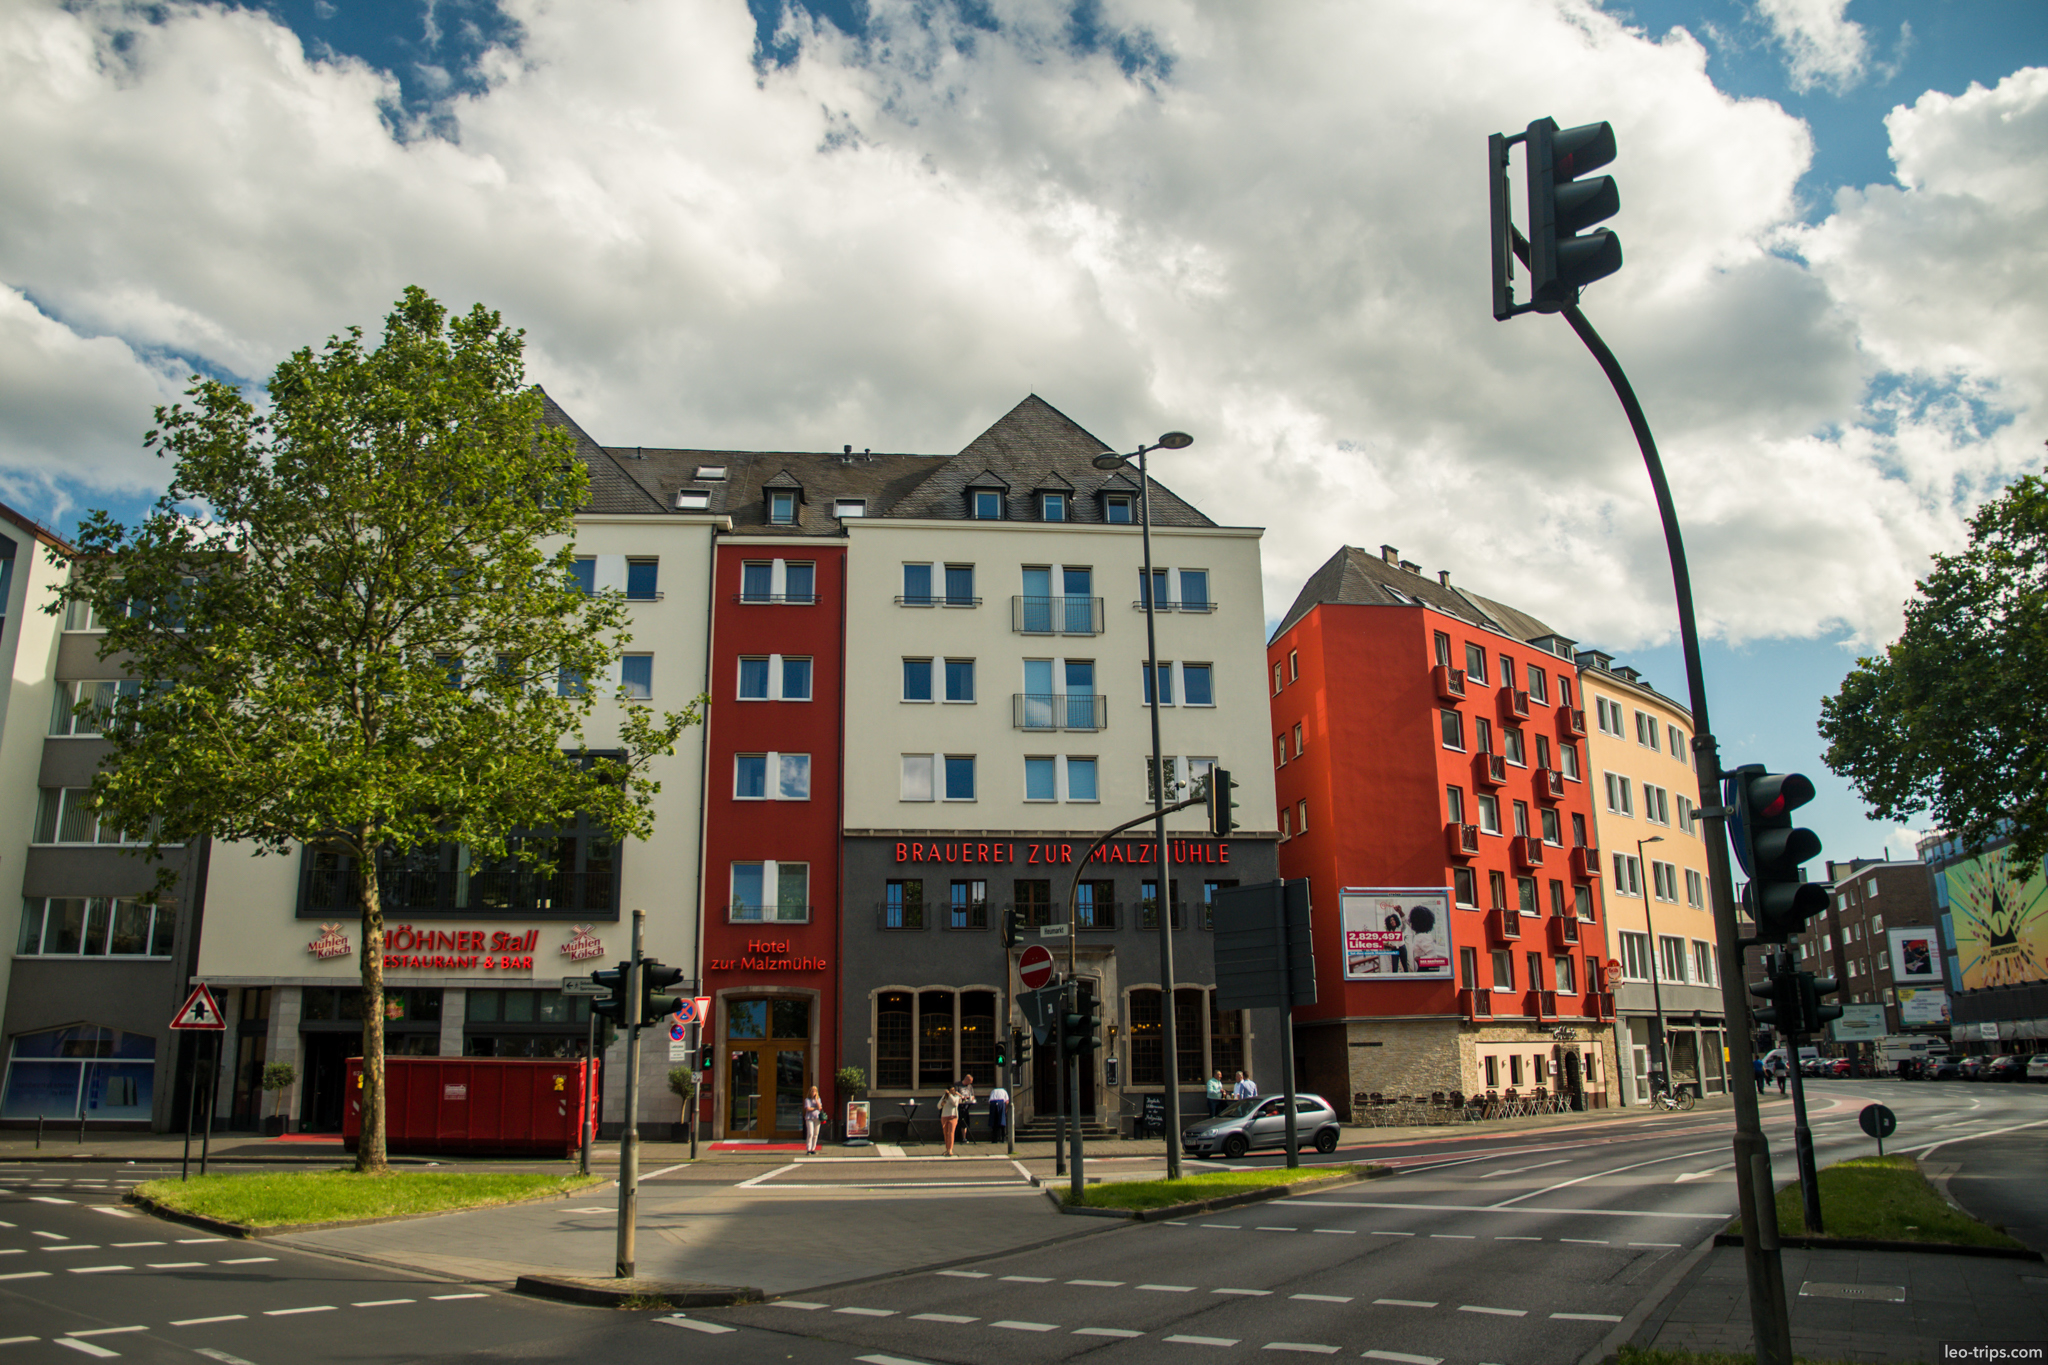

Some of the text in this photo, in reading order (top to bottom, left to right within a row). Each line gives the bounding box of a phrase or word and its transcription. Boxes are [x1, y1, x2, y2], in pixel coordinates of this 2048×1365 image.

[896, 843, 1013, 862] BRAUEREI
[1027, 844, 1072, 863] ZUR
[307, 936, 348, 951] Mühlen
[490, 930, 539, 951] Stall
[1349, 932, 1401, 941] 2,829,497
[317, 945, 351, 959] Kölsch
[560, 938, 601, 953] Mühlen
[748, 939, 790, 953] Hotel
[1350, 941, 1382, 949] Likes.
[571, 946, 604, 960] Kölsch
[383, 955, 532, 969] ESTAURANT & BAR
[711, 956, 826, 970] zur Malzmühle
